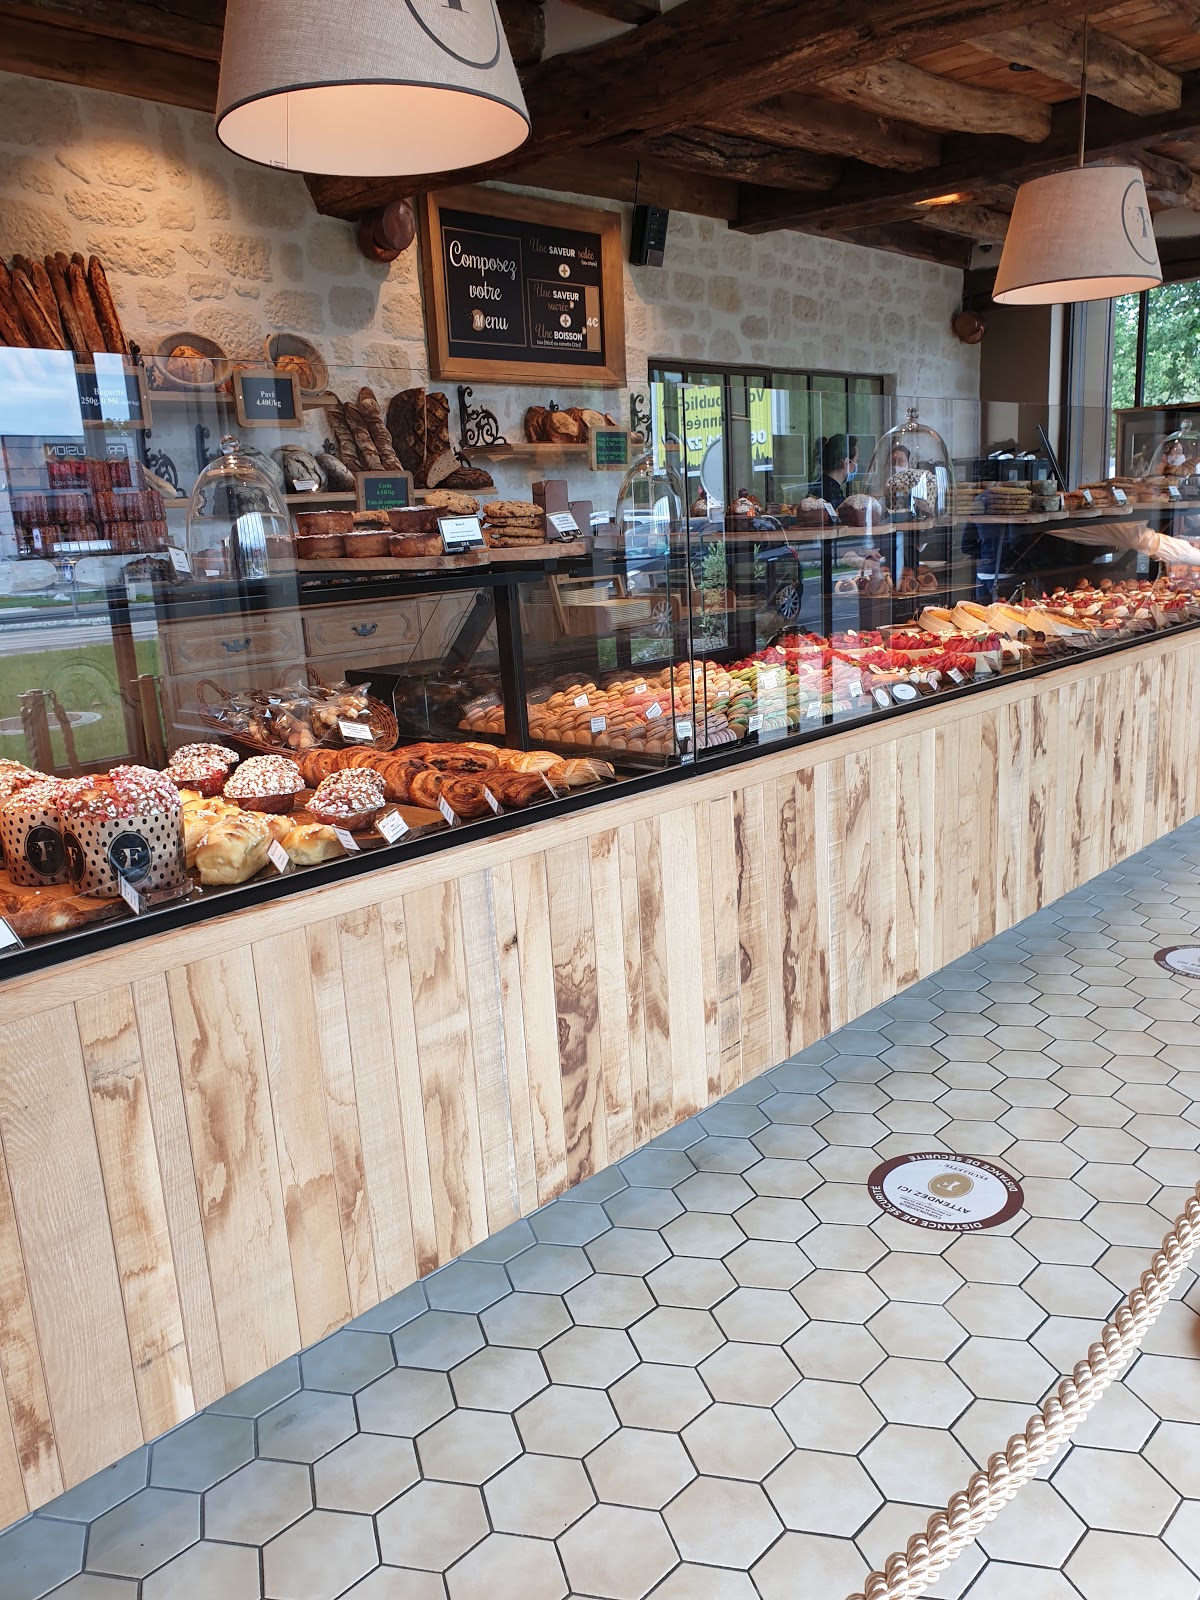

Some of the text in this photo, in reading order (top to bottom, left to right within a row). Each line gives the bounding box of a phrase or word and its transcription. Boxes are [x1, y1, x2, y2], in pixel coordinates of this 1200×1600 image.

[530, 237, 548, 253] Une
[548, 246, 576, 258] SAVEUR
[450, 240, 517, 280] Composez
[469, 281, 502, 301] votre
[533, 282, 580, 301] Une SAVEUR
[547, 301, 569, 312] sucrée
[473, 314, 509, 331] Menu
[586, 317, 599, 328] 4€
[534, 323, 583, 342] Une BOISSON
[93, 387, 125, 397] Baguette
[260, 390, 276, 398] Pavé
[34, 840, 56, 862] F
[66, 846, 78, 867] F
[120, 846, 143, 869] F
[907, 1154, 1018, 1192] DISTANCE DE SÉCURITÉ
[944, 1163, 989, 1181] FEUILLETTE
[870, 1185, 983, 1231] DISTANCE DE SÉCURITÉ
[896, 1185, 971, 1214] ATTENDEZ ICI
[899, 1202, 942, 1220] CORONAVIRUS
